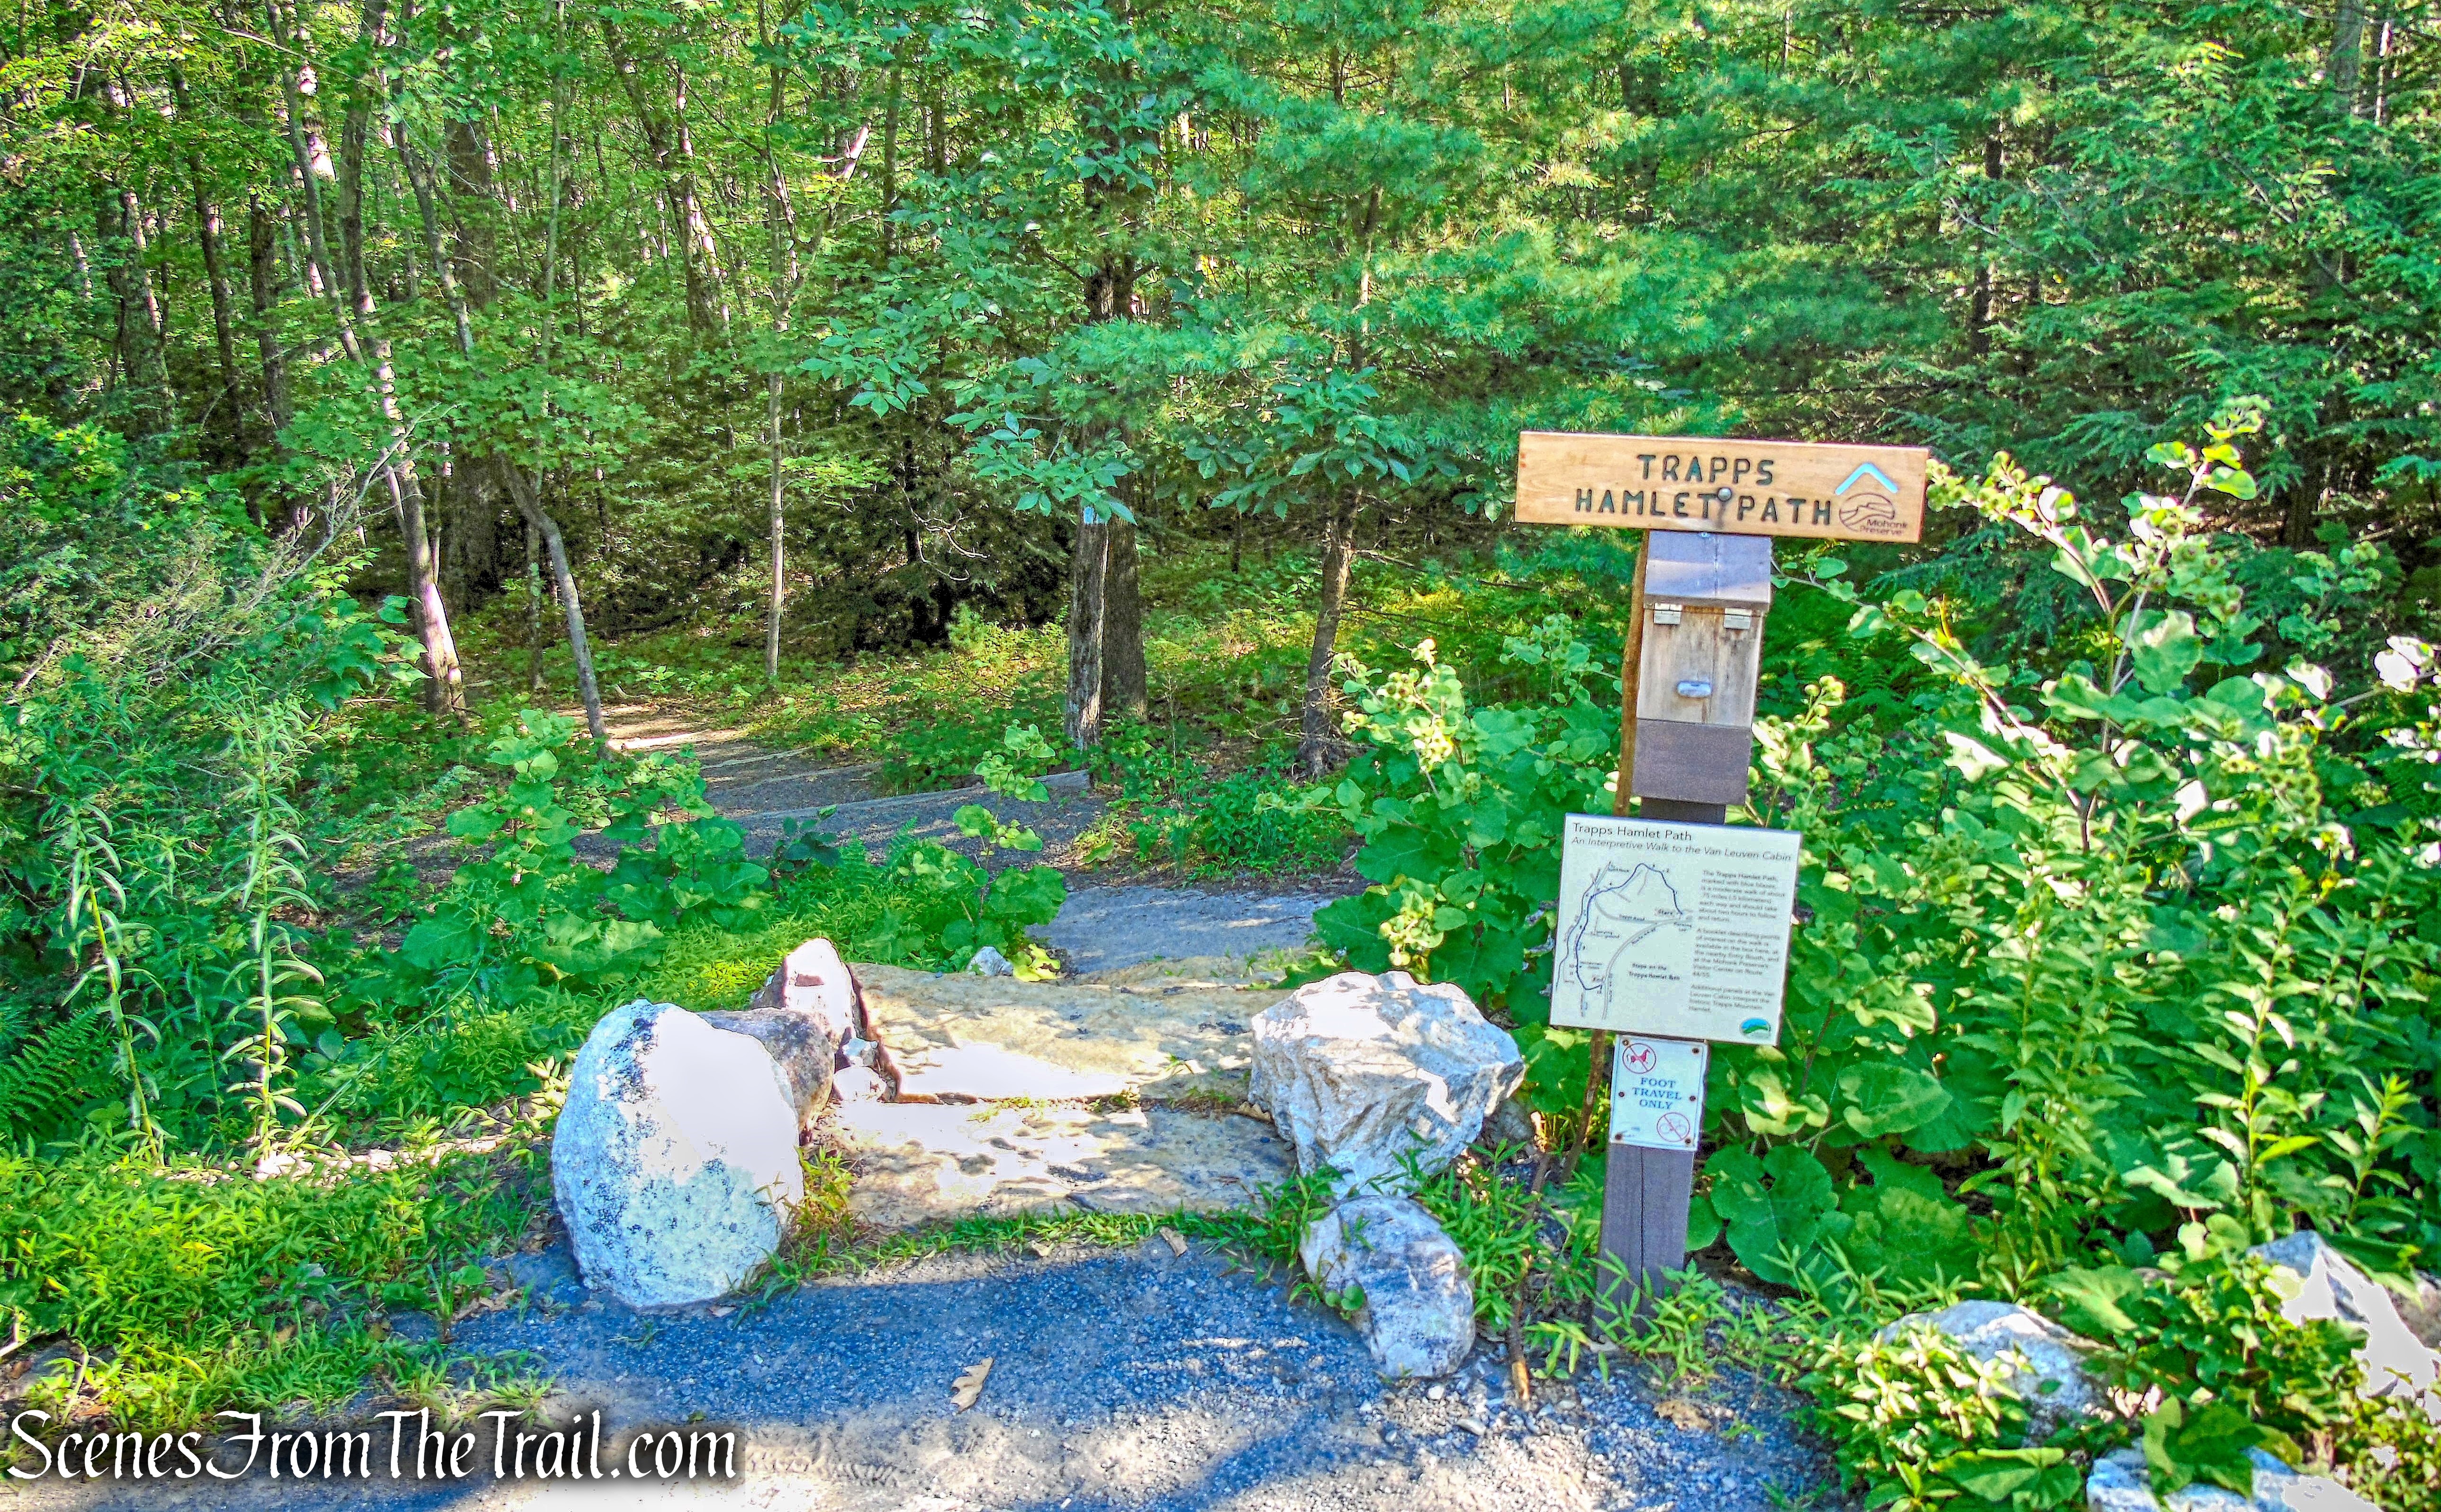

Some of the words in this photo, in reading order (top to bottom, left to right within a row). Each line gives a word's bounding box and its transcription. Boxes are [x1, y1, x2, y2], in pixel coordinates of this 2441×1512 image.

[1637, 454, 1775, 486] TRAPPS
[1575, 488, 1718, 519] HAMLET
[1736, 495, 1831, 525] PATH
[1867, 519, 1907, 528] Mohonk
[1860, 526, 1902, 535] Preserve
[1573, 822, 1612, 837] Trapps
[1618, 826, 1660, 838] Hamlet
[1665, 830, 1691, 841] Path
[1588, 838, 1643, 849] Interpretive
[1646, 842, 1668, 851] Walk
[1705, 847, 1720, 855] Van
[1725, 847, 1759, 858] Leuven
[1763, 851, 1791, 861] Cabin
[1640, 1078, 1676, 1089] FOOT
[1632, 1088, 1682, 1100] TRAVEL
[1639, 1099, 1673, 1109] ONLY
